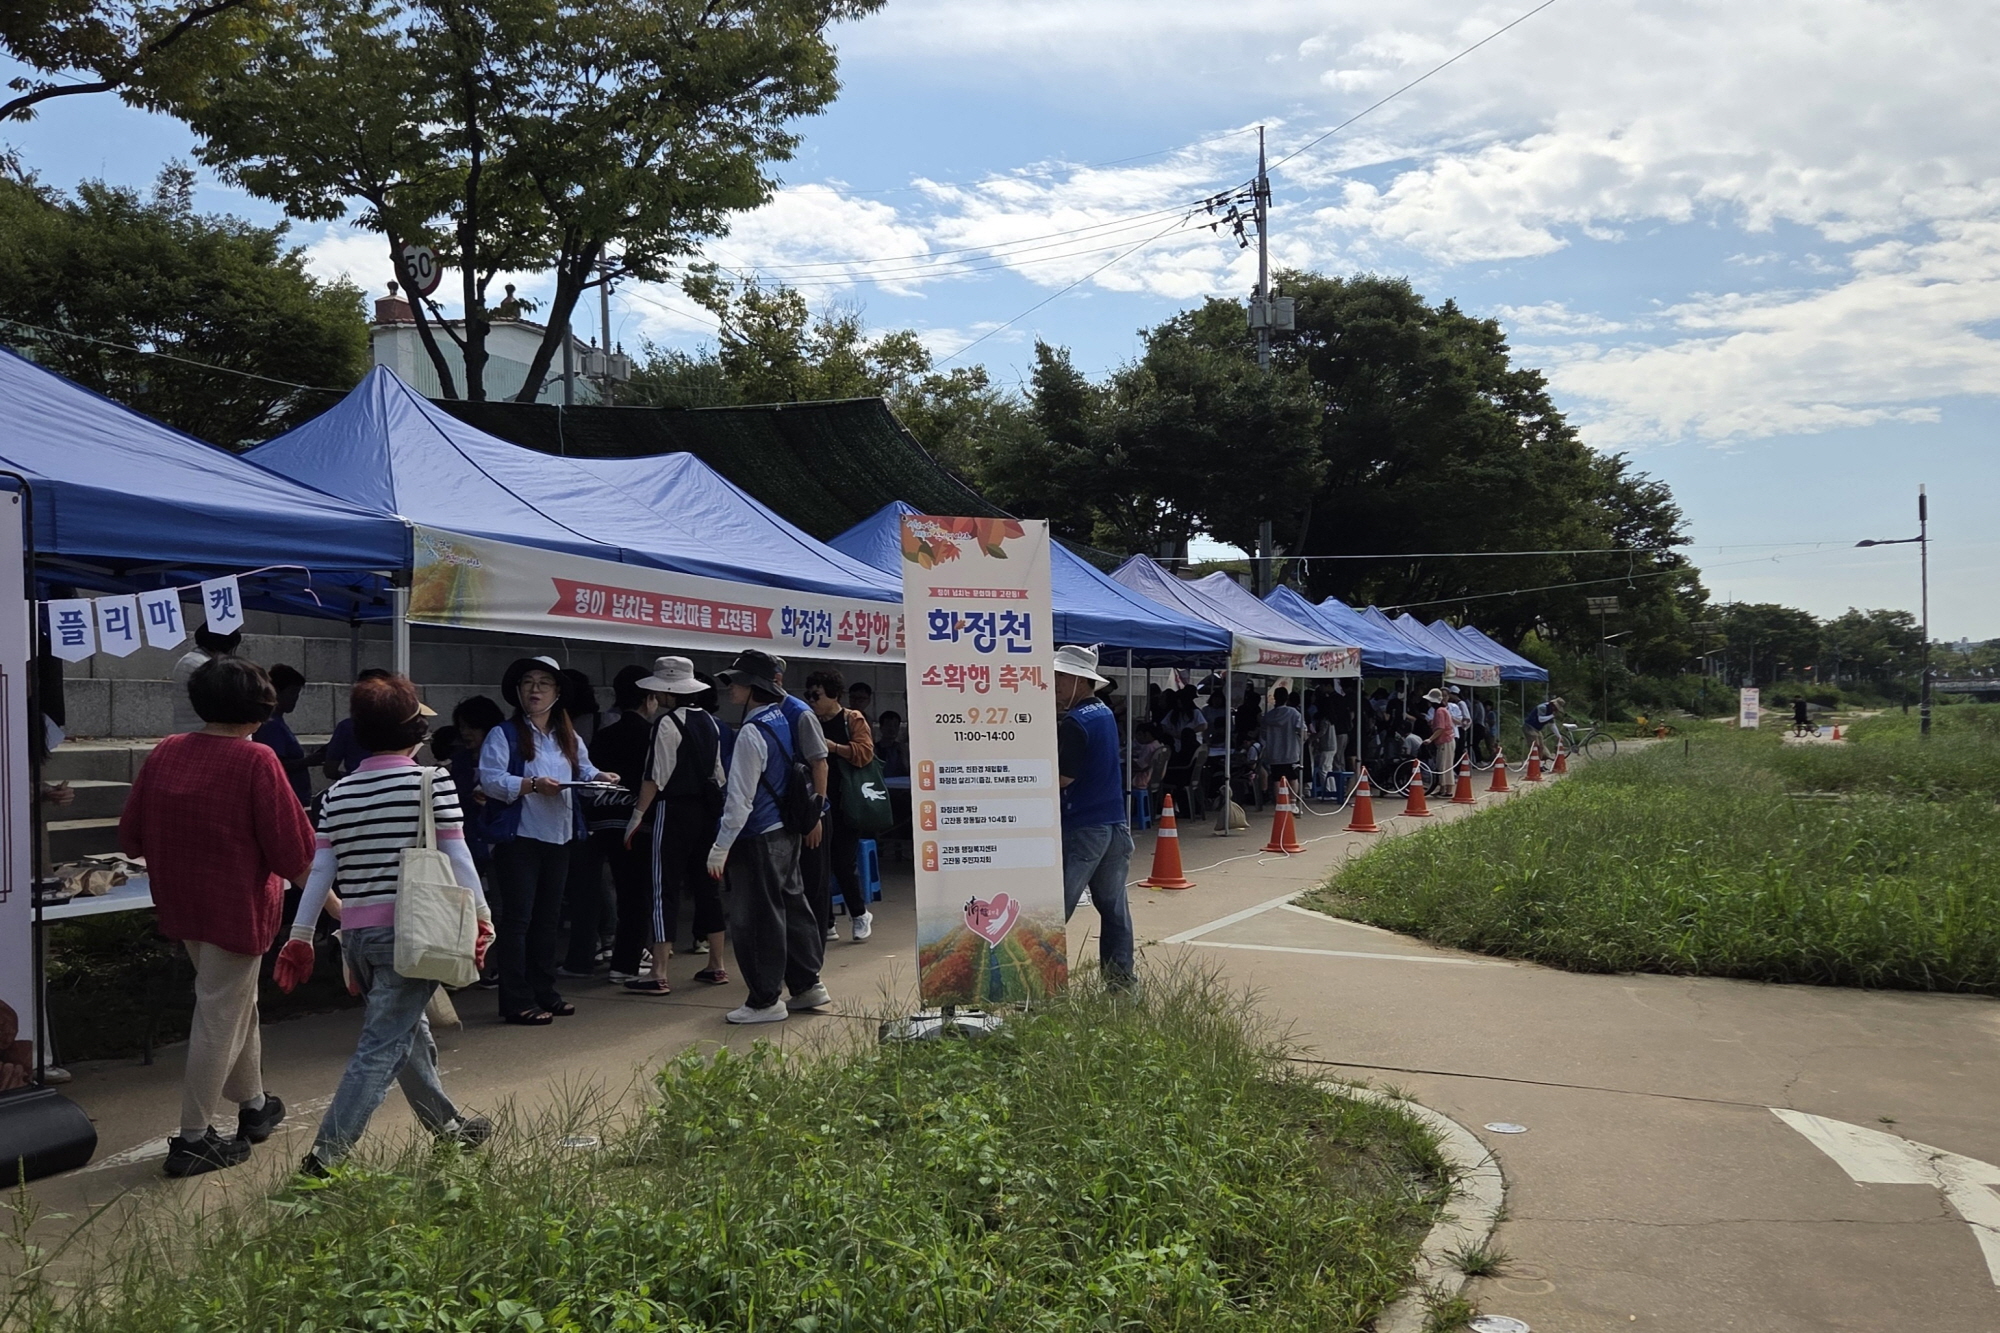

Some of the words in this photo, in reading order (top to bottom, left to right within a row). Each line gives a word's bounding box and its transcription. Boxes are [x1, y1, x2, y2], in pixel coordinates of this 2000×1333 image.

[406, 252, 432, 278] 50
[952, 589, 971, 597] 넘치는
[973, 589, 997, 597] 문화마을
[575, 588, 606, 615] 정이
[612, 593, 654, 622] 넘치는
[660, 600, 712, 628] 문화마을
[717, 607, 757, 633] 고잔동!
[781, 605, 832, 648] 화정천
[837, 609, 890, 655] 소확행
[928, 609, 1032, 653] 화정천
[922, 664, 990, 694] 소확행
[999, 664, 1042, 694] 축제
[954, 731, 1015, 741] 11:00~14:00
[940, 816, 962, 825] (고잔동
[942, 846, 960, 854] 고잔동
[961, 845, 997, 853] 행정복지센터
[942, 857, 960, 865] 고잔동
[961, 856, 991, 864] 주민자치회
